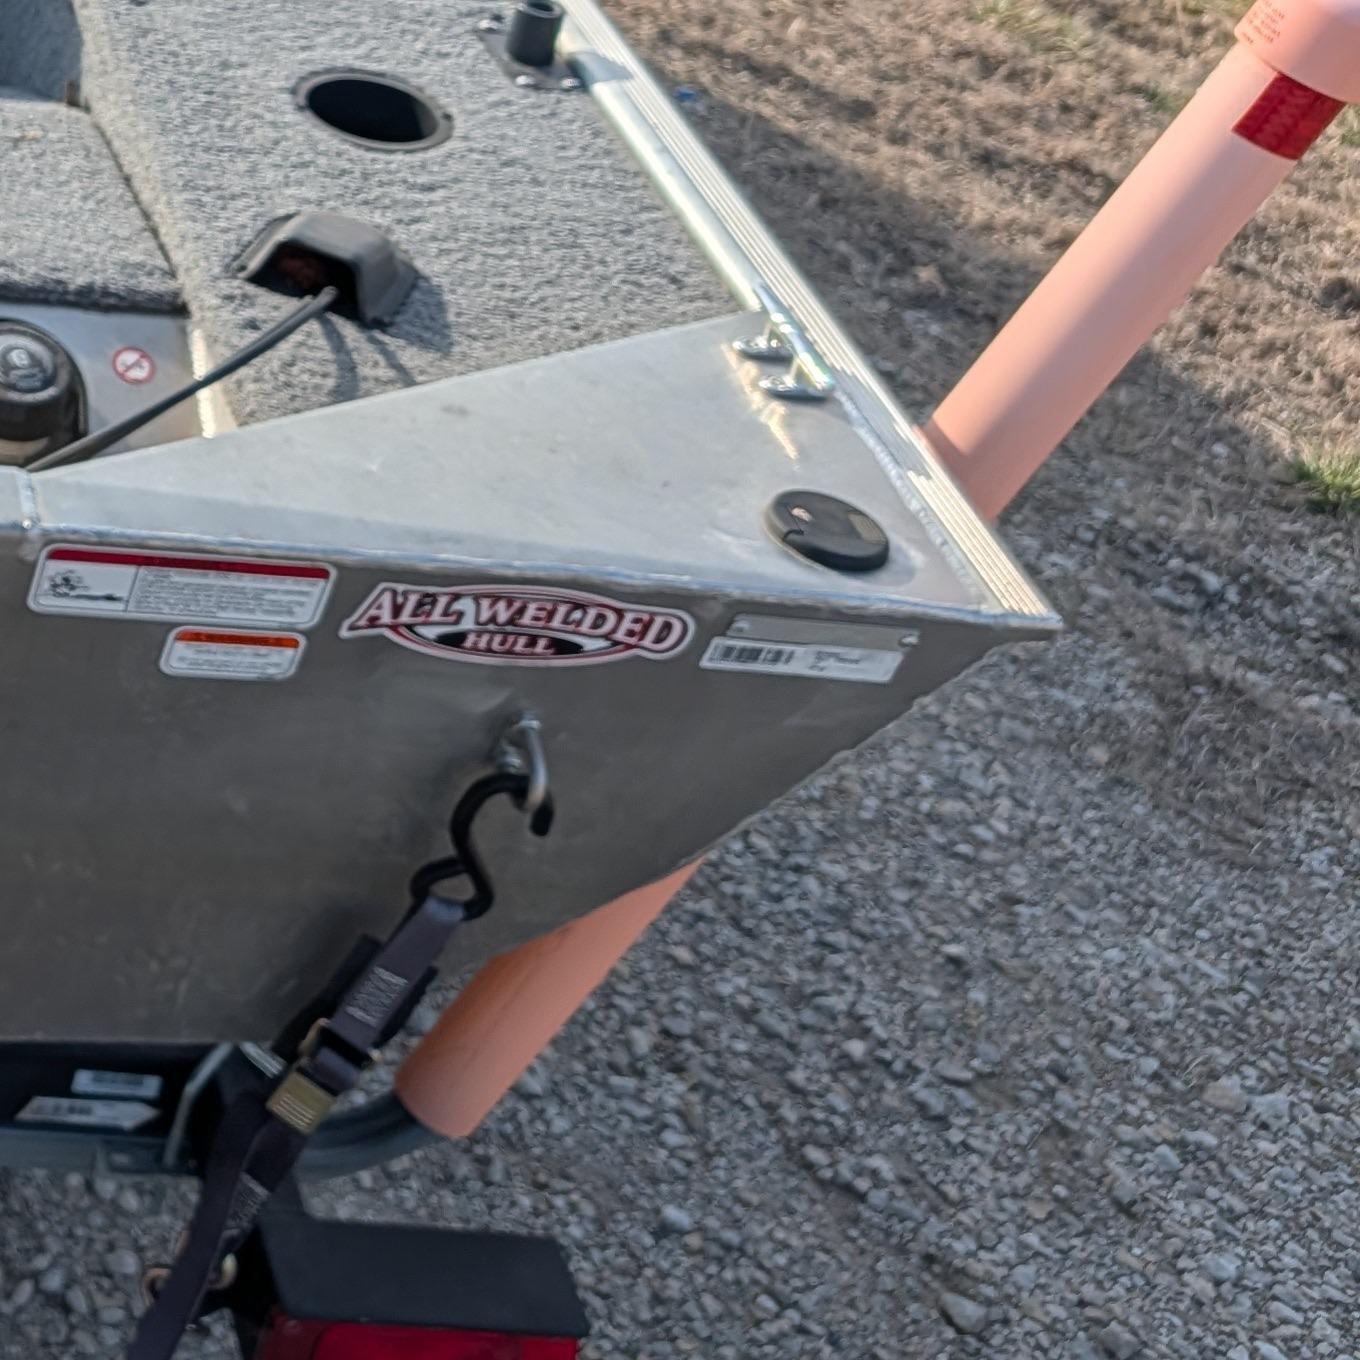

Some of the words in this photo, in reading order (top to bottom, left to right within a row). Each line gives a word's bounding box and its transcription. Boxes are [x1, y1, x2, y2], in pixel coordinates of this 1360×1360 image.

[354, 588, 459, 628] ALL
[475, 595, 683, 652] WELDED
[460, 630, 556, 656] HULL
